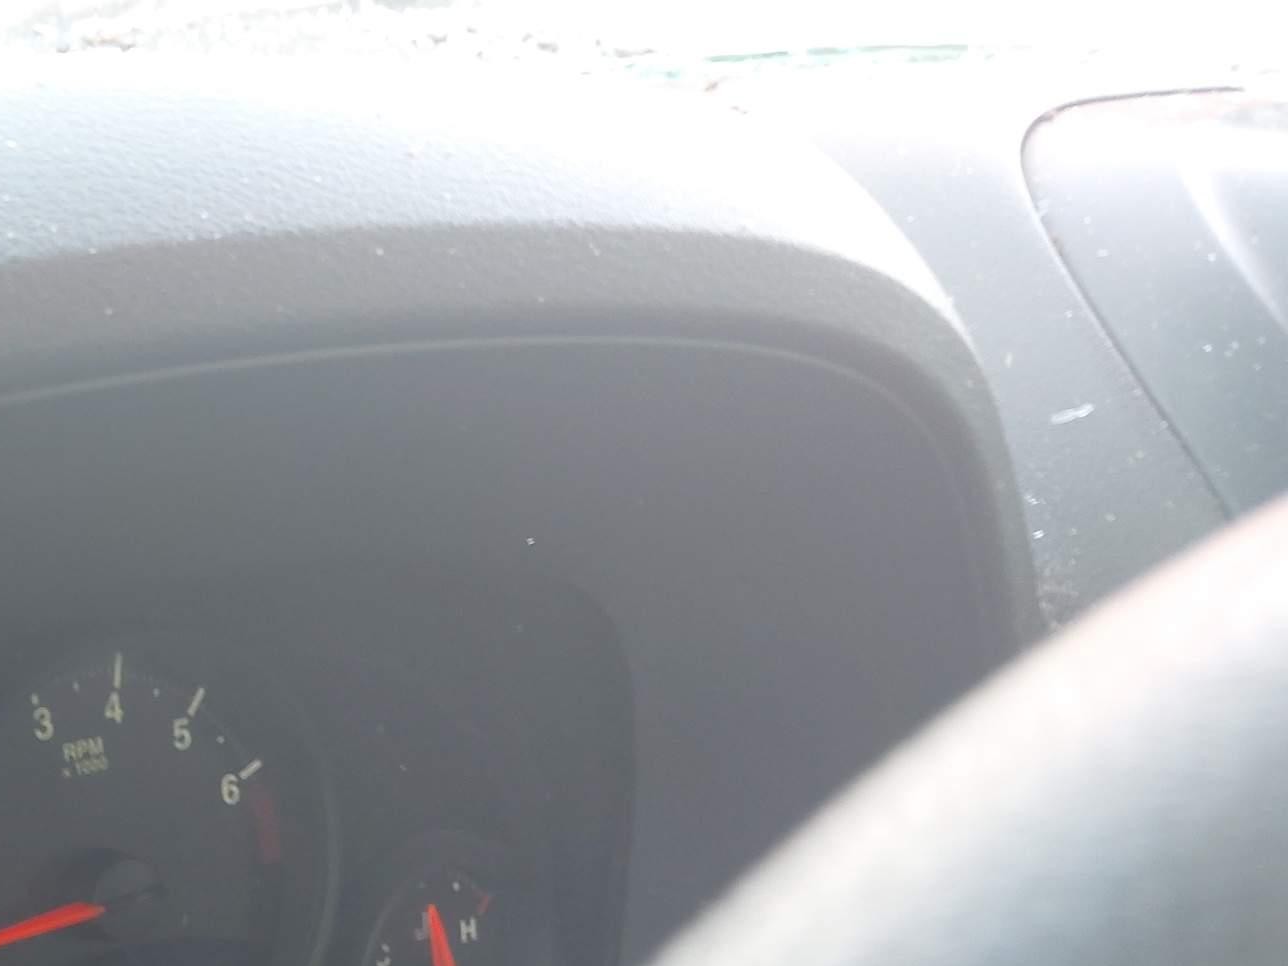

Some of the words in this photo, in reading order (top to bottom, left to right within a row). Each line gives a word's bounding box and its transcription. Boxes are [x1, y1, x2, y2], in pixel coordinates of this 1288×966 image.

[105, 692, 123, 723] 4
[33, 707, 54, 741] 3
[173, 717, 192, 750] 5
[62, 736, 105, 762] RPM
[221, 774, 240, 804] 6
[460, 917, 477, 943] H
